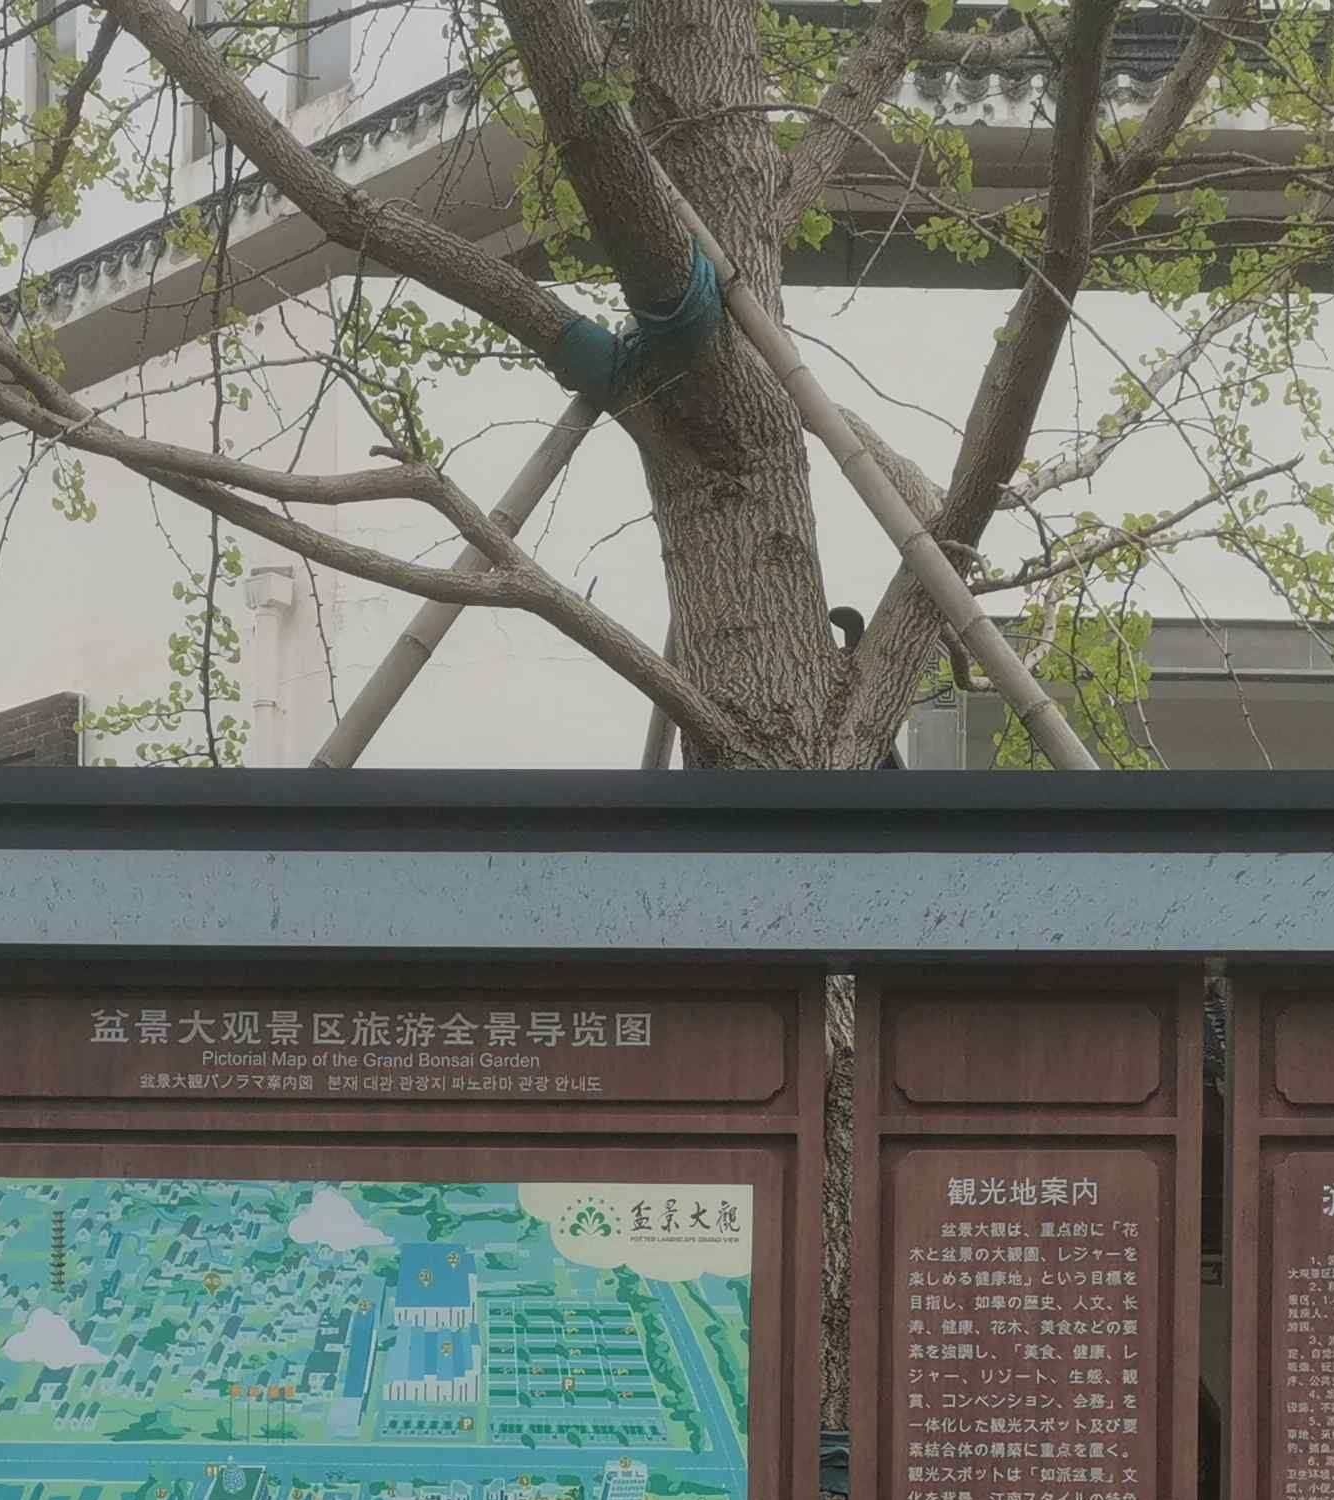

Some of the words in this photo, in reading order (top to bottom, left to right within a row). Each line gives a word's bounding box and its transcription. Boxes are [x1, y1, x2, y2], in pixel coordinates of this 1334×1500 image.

[89, 1009, 652, 1048] 盆景大观景区旅游全景导览图
[202, 1049, 267, 1068] Pictorial
[271, 1050, 308, 1070] Map
[311, 1050, 329, 1067] of
[332, 1051, 359, 1068] the
[362, 1052, 414, 1069] Grand
[418, 1051, 475, 1069] Bonsai
[479, 1052, 541, 1070] Garden
[946, 1175, 1098, 1207] 観光地案内
